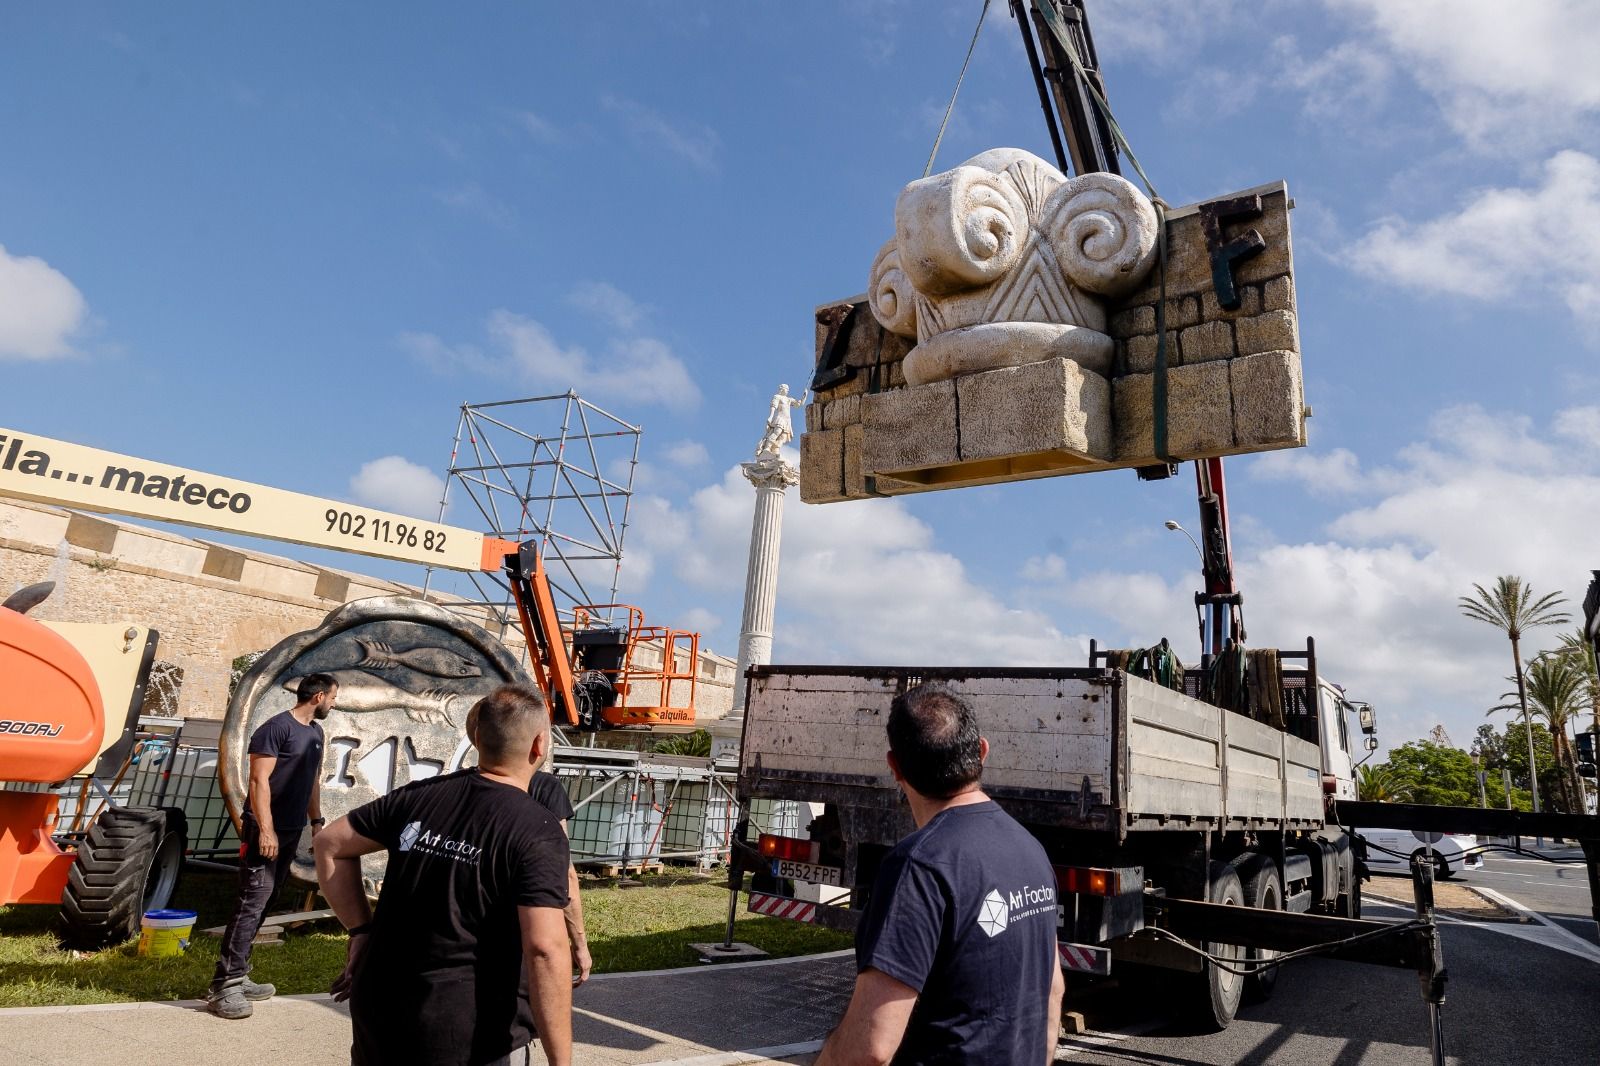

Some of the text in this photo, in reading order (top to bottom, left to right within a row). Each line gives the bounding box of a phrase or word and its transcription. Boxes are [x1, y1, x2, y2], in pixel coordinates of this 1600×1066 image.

[99, 465, 252, 514] mateco
[325, 509, 366, 538] 902
[423, 529, 447, 553] 82
[419, 829, 441, 847] Art
[780, 861, 837, 884] 8552 FPF
[1009, 890, 1024, 911] Art
